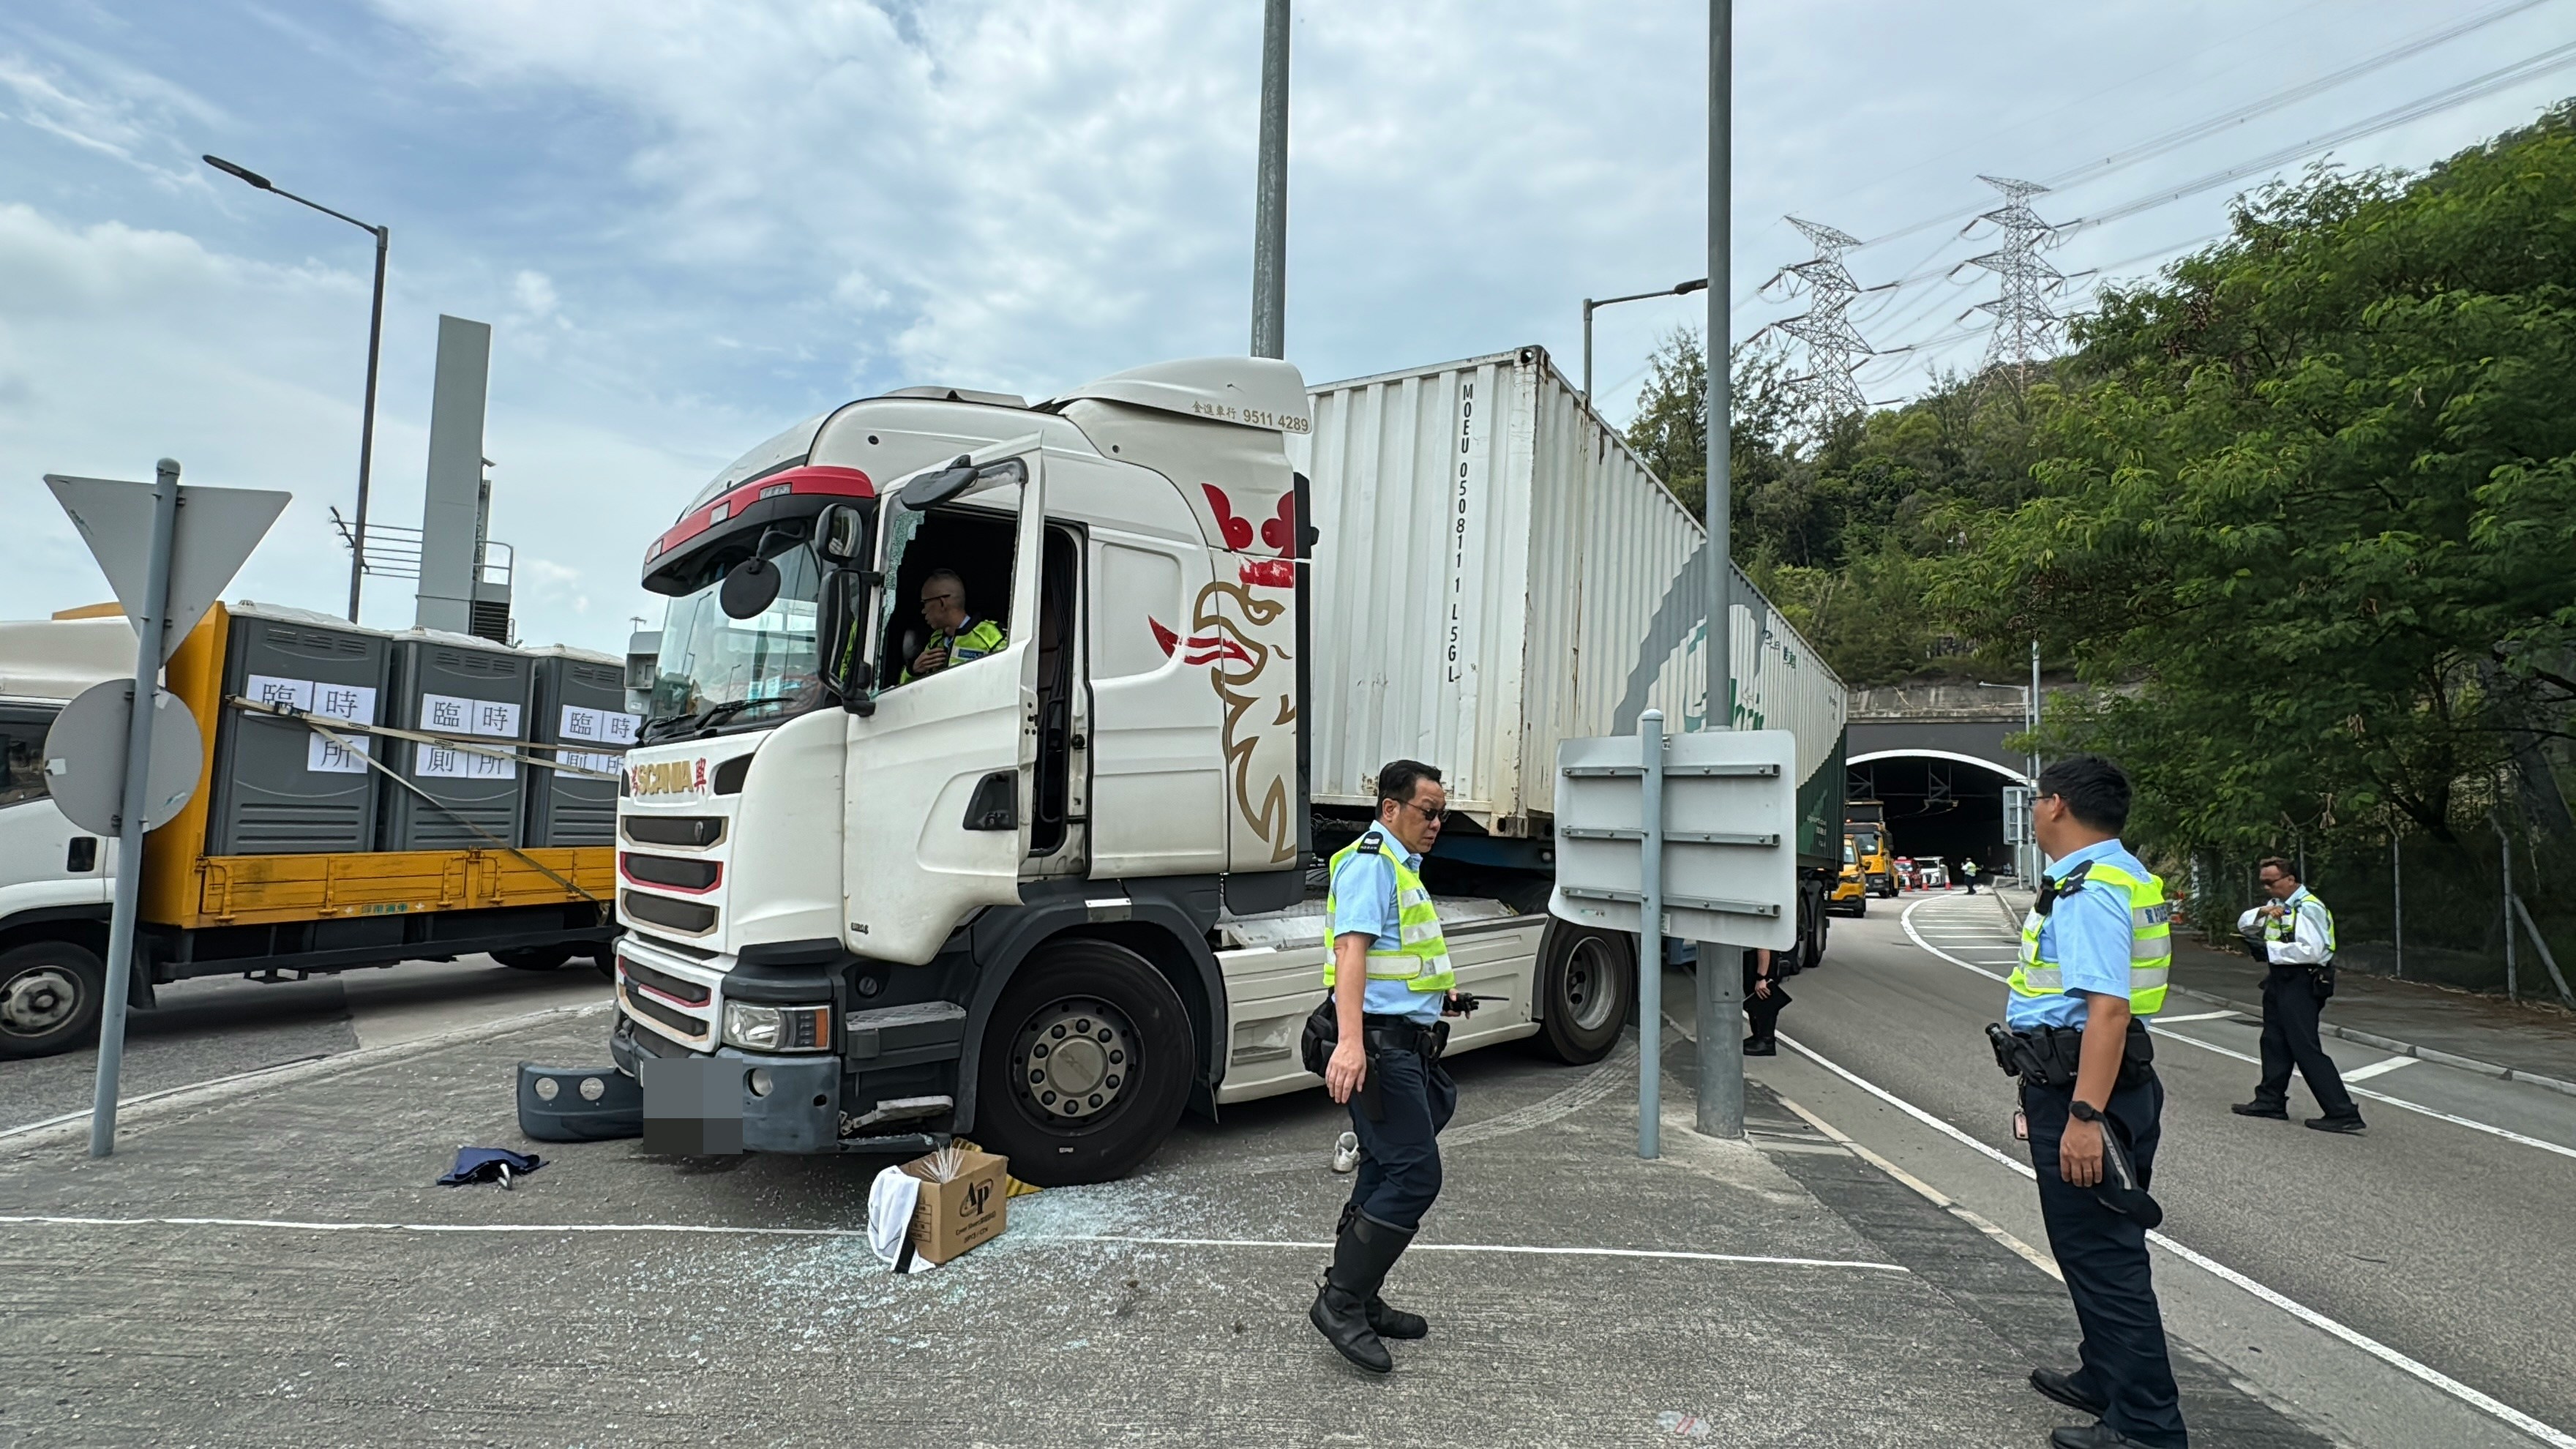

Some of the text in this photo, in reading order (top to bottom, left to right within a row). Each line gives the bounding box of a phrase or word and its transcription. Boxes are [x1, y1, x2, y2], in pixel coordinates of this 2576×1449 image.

[1243, 408, 1273, 427] 9511
[1278, 414, 1308, 432] 4289
[1461, 383, 1474, 454] MOEU
[1456, 462, 1469, 569] 050811
[1454, 577, 1461, 594] 1
[433, 700, 509, 732] 臨時
[569, 711, 631, 738] 臨時
[637, 760, 694, 795] SCANIA
